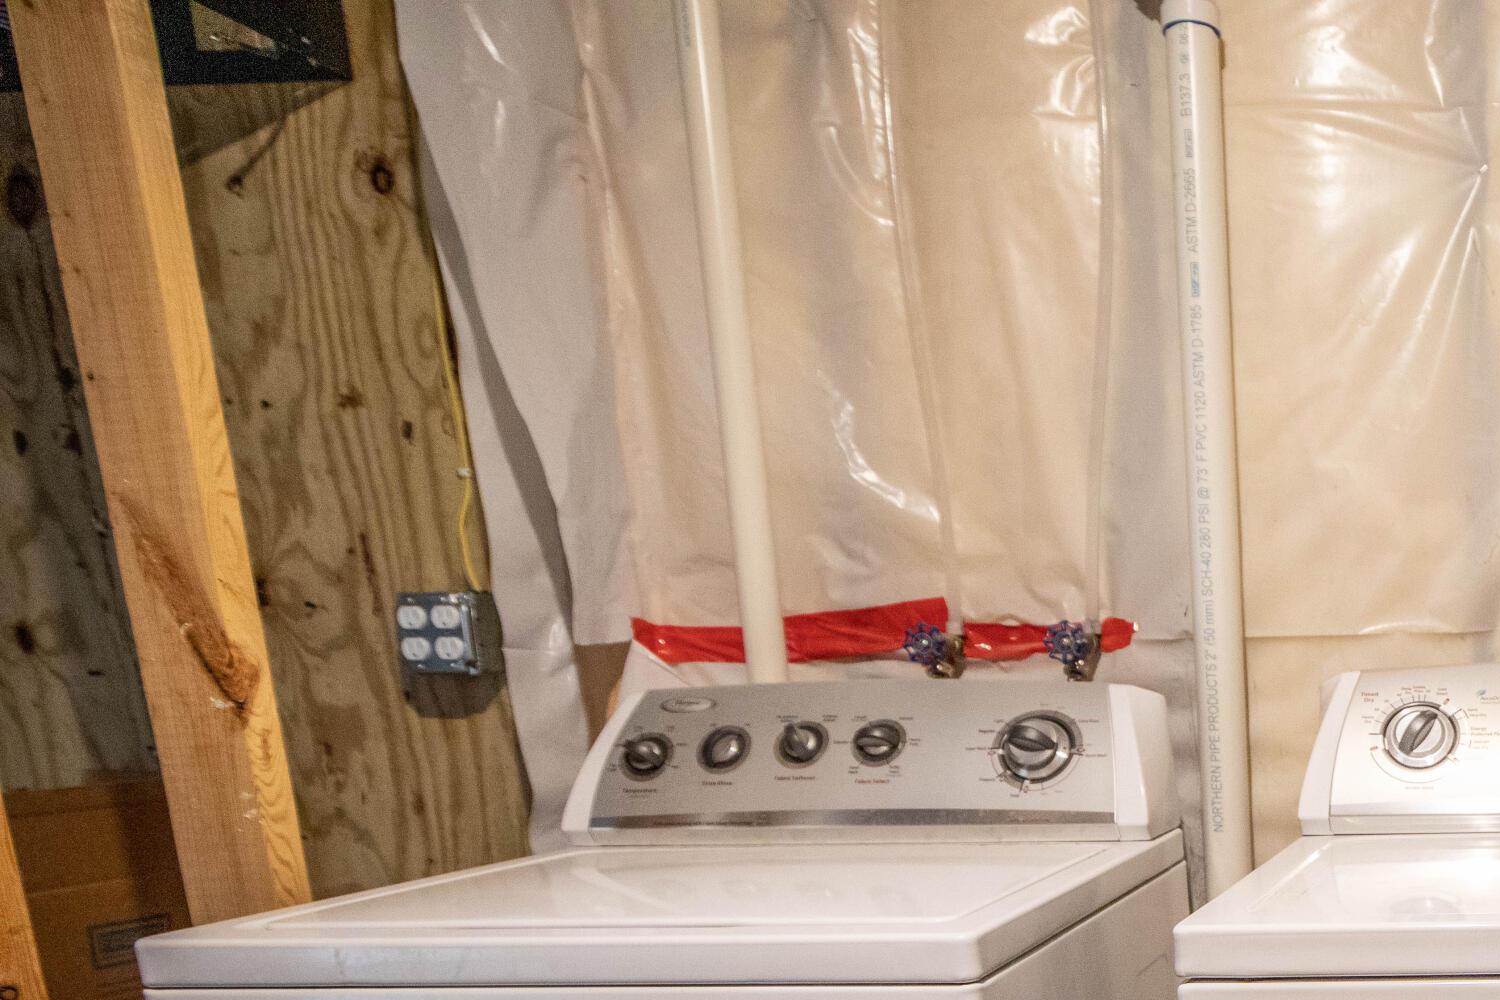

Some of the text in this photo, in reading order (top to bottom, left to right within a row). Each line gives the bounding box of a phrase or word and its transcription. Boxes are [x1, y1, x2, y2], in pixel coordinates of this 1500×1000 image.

[1185, 216, 1199, 254] ASTM
[1192, 352, 1205, 388] ASTM
[1195, 423, 1208, 450] PVC
[1206, 663, 1219, 733] PRODUCTS
[1208, 735, 1221, 763] PIPE
[1209, 765, 1224, 832] NORTHERN
